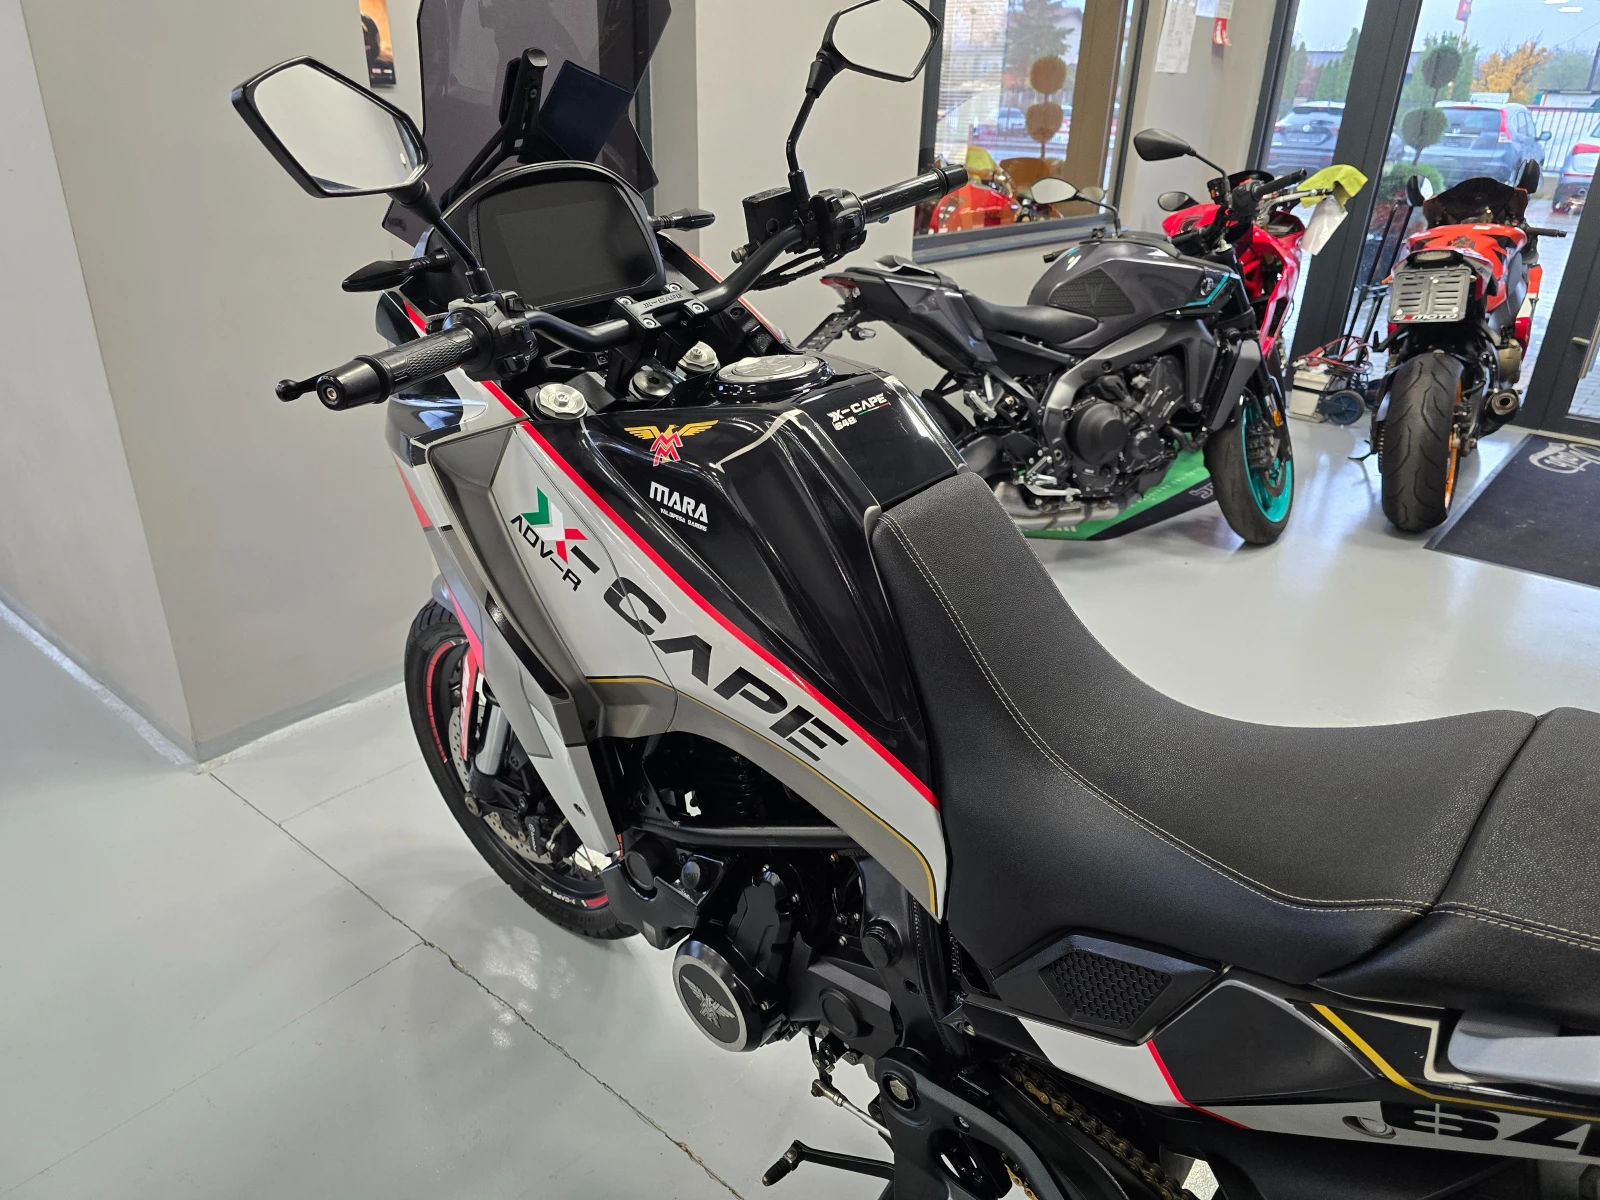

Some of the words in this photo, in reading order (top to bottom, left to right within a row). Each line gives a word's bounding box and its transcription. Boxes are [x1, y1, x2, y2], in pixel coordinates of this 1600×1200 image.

[826, 393, 888, 422] X-CAPE
[649, 481, 708, 523] MARA
[510, 514, 582, 592] ADV-R
